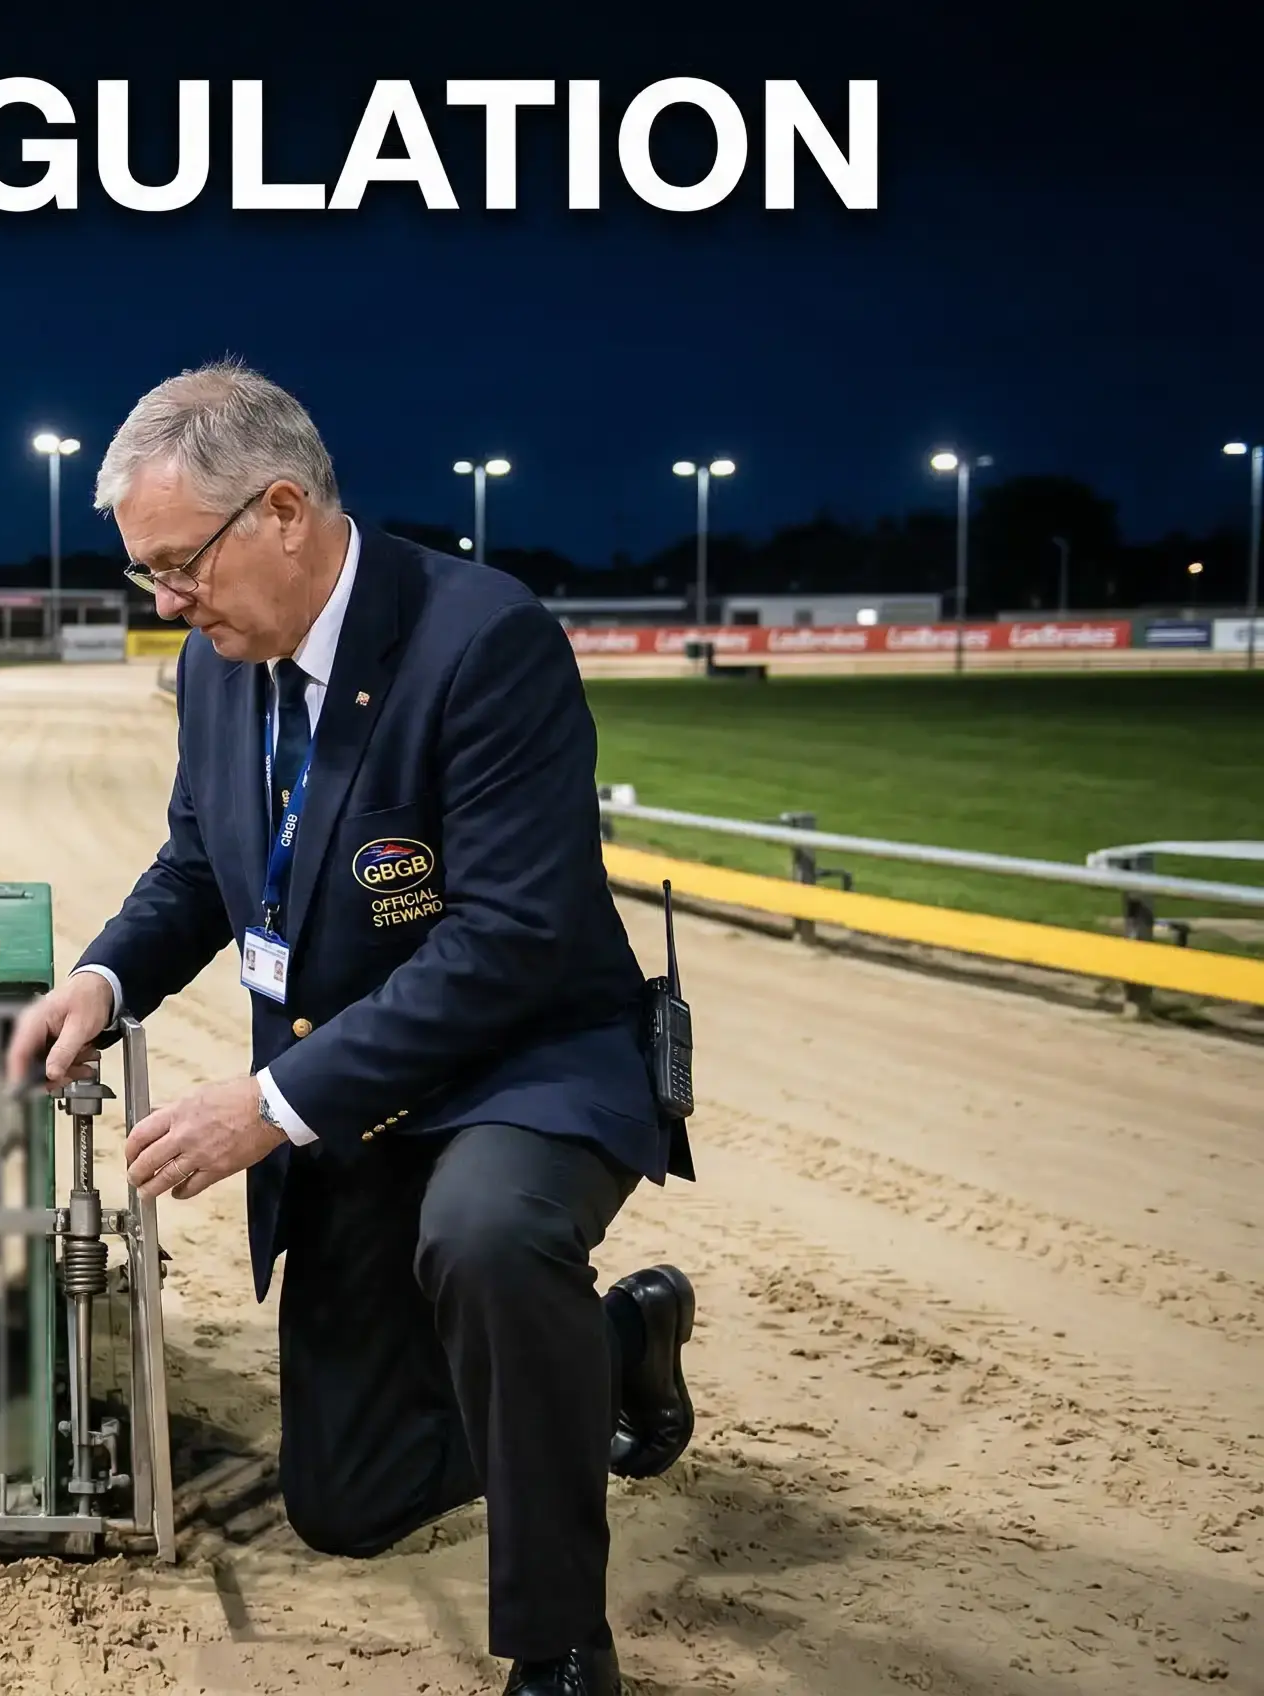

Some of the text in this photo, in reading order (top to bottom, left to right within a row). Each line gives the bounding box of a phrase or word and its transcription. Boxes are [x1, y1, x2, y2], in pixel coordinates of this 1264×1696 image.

[1008, 622, 1118, 649] Ladbrokes
[364, 855, 428, 884] GBGB
[371, 887, 438, 912] OFFICIAL
[373, 900, 443, 927] STEWARD
